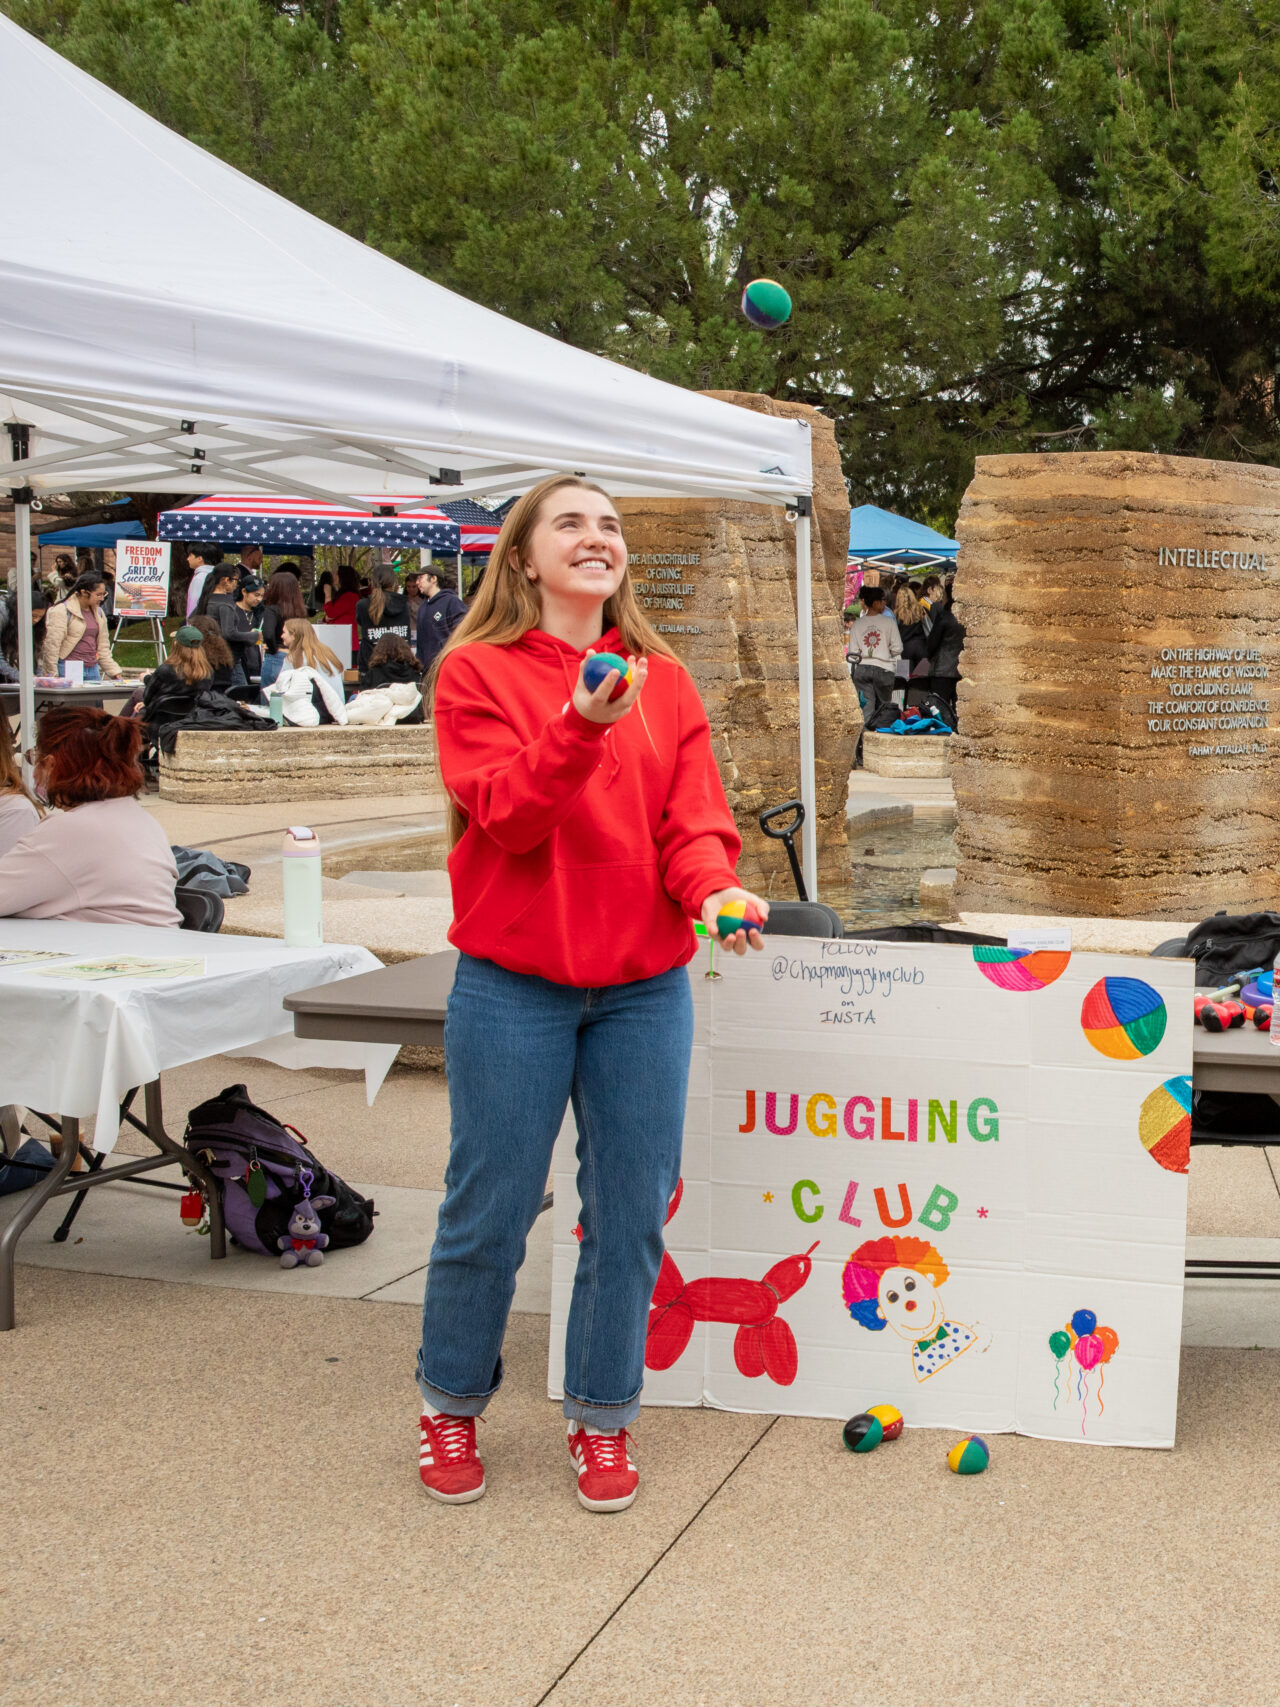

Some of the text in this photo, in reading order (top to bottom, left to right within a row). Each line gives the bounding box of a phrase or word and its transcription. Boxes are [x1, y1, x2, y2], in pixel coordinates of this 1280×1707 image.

[125, 545, 162, 557] FREEDOM
[130, 556, 157, 566] TO TRY
[1159, 547, 1267, 571] INTELLECTUAL
[128, 566, 158, 576] GRIT TO
[121, 571, 165, 584] Succeed
[1161, 649, 1177, 661] ON
[1178, 649, 1193, 661] THE
[1194, 649, 1233, 660] HIGHWAY
[1234, 649, 1246, 660] OF
[1151, 666, 1268, 678] MAKE THE FLAME OF WISDOM
[1169, 684, 1192, 696] YOUR
[1193, 684, 1229, 696] GUIDING
[1148, 700, 1269, 714] THE COMFORT OF CONFIDENCE
[1148, 719, 1171, 732] YOUR
[1172, 718, 1217, 731] CONSTANT
[1188, 746, 1214, 757] FAHMY
[818, 1009, 877, 1025] INSTA
[738, 1089, 1000, 1144] JUGGLING
[791, 1178, 959, 1232] CLUB
